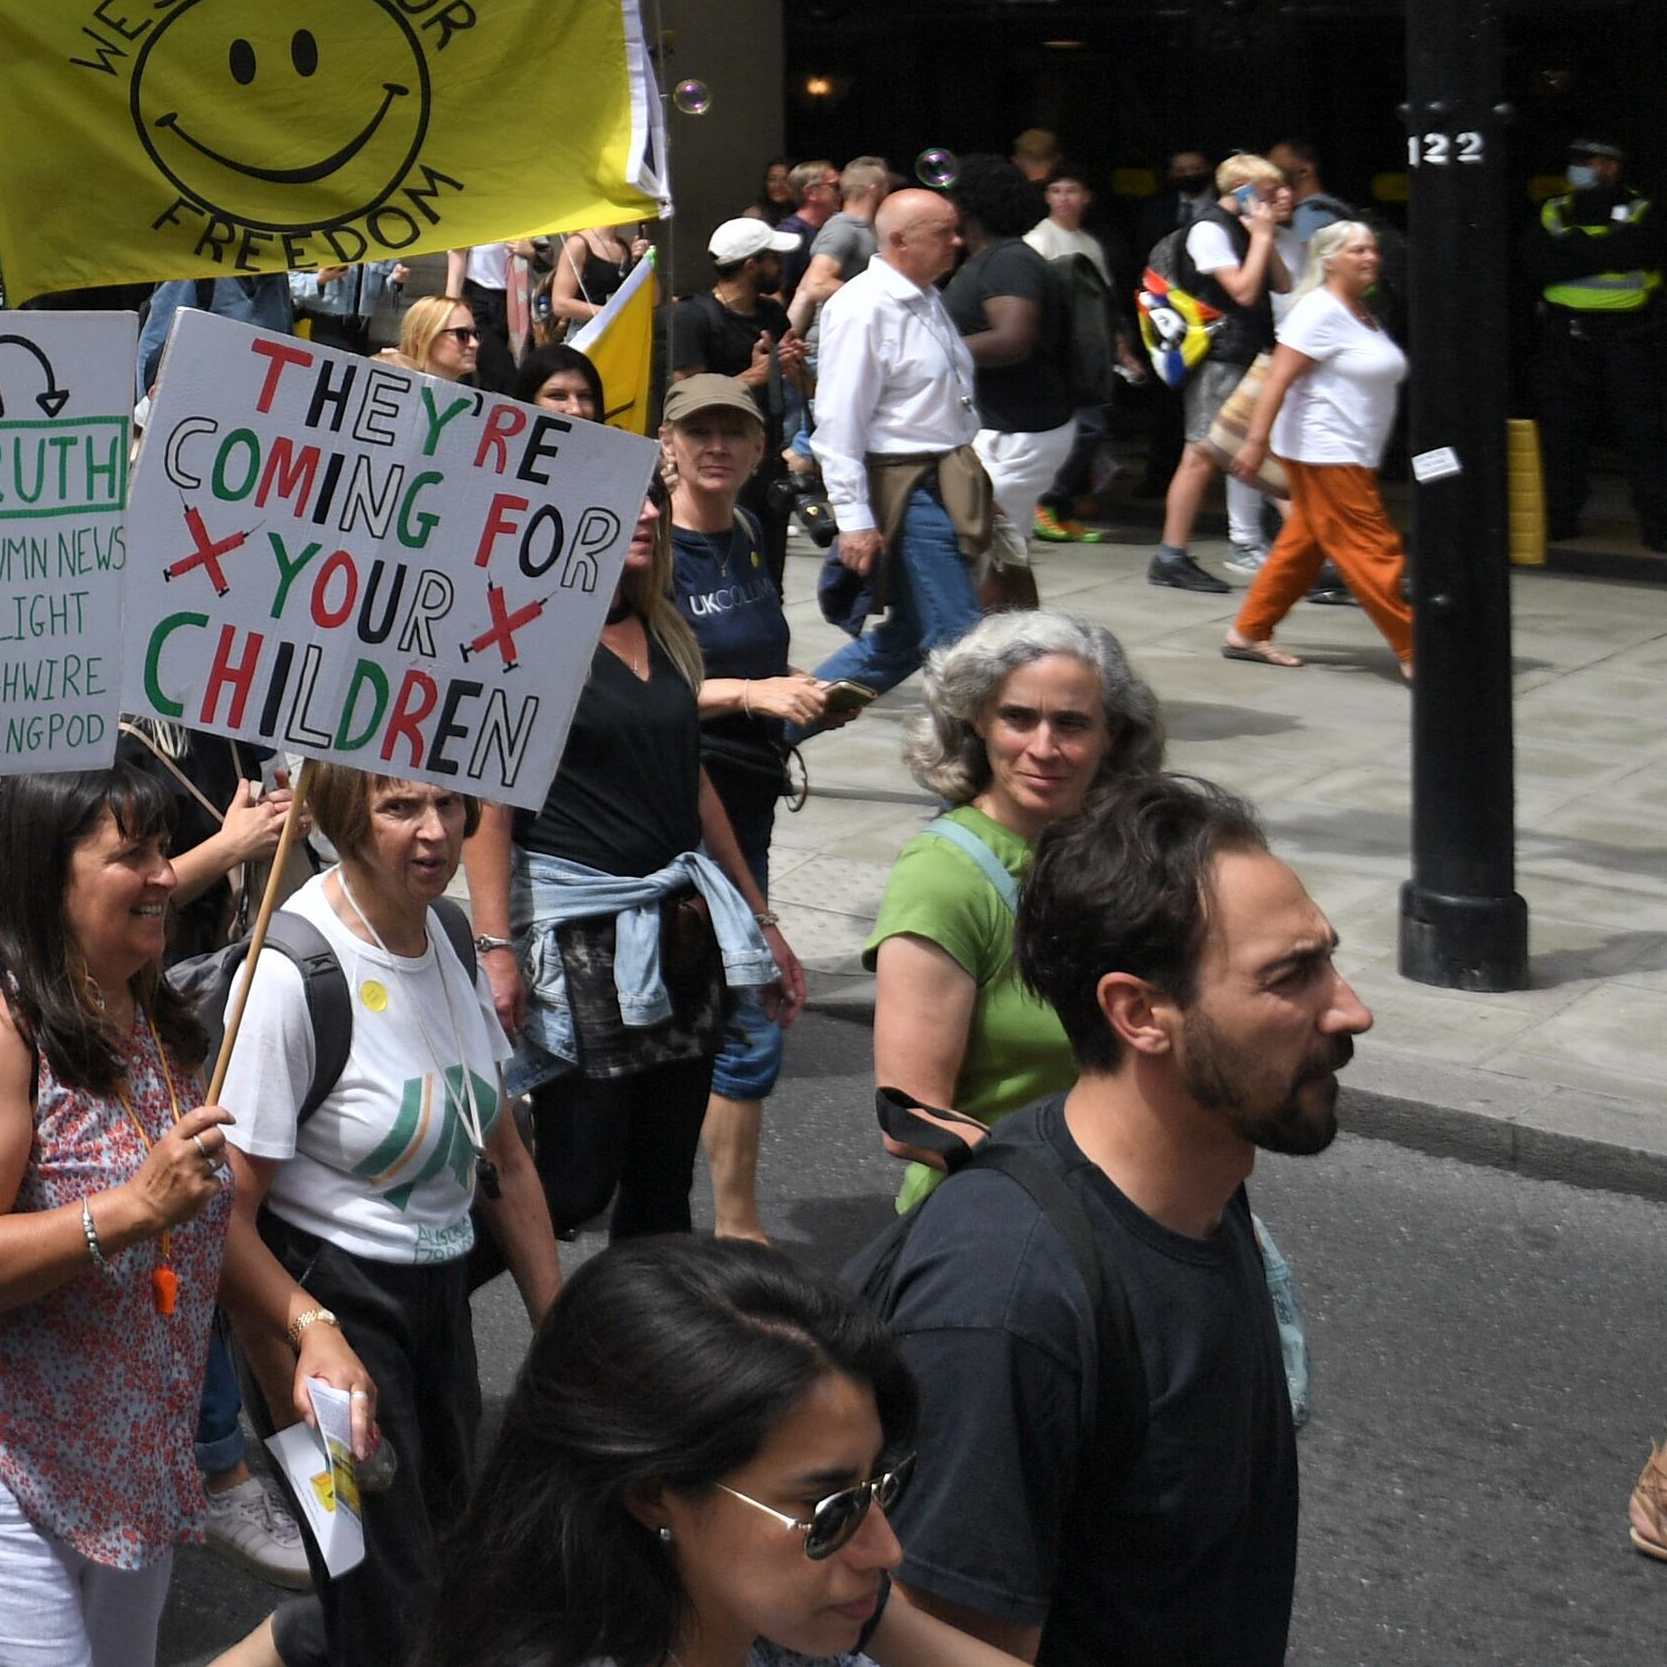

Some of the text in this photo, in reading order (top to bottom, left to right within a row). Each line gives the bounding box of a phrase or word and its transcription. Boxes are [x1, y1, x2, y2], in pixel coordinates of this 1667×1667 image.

[1408, 132, 1483, 168] 122
[151, 164, 465, 272] FREEDOM
[251, 337, 572, 486] THEY'RE
[57, 524, 127, 580] NEWS
[164, 415, 621, 593] COMING FOR
[266, 531, 455, 659] YOUR
[143, 611, 541, 789] CHILDREN
